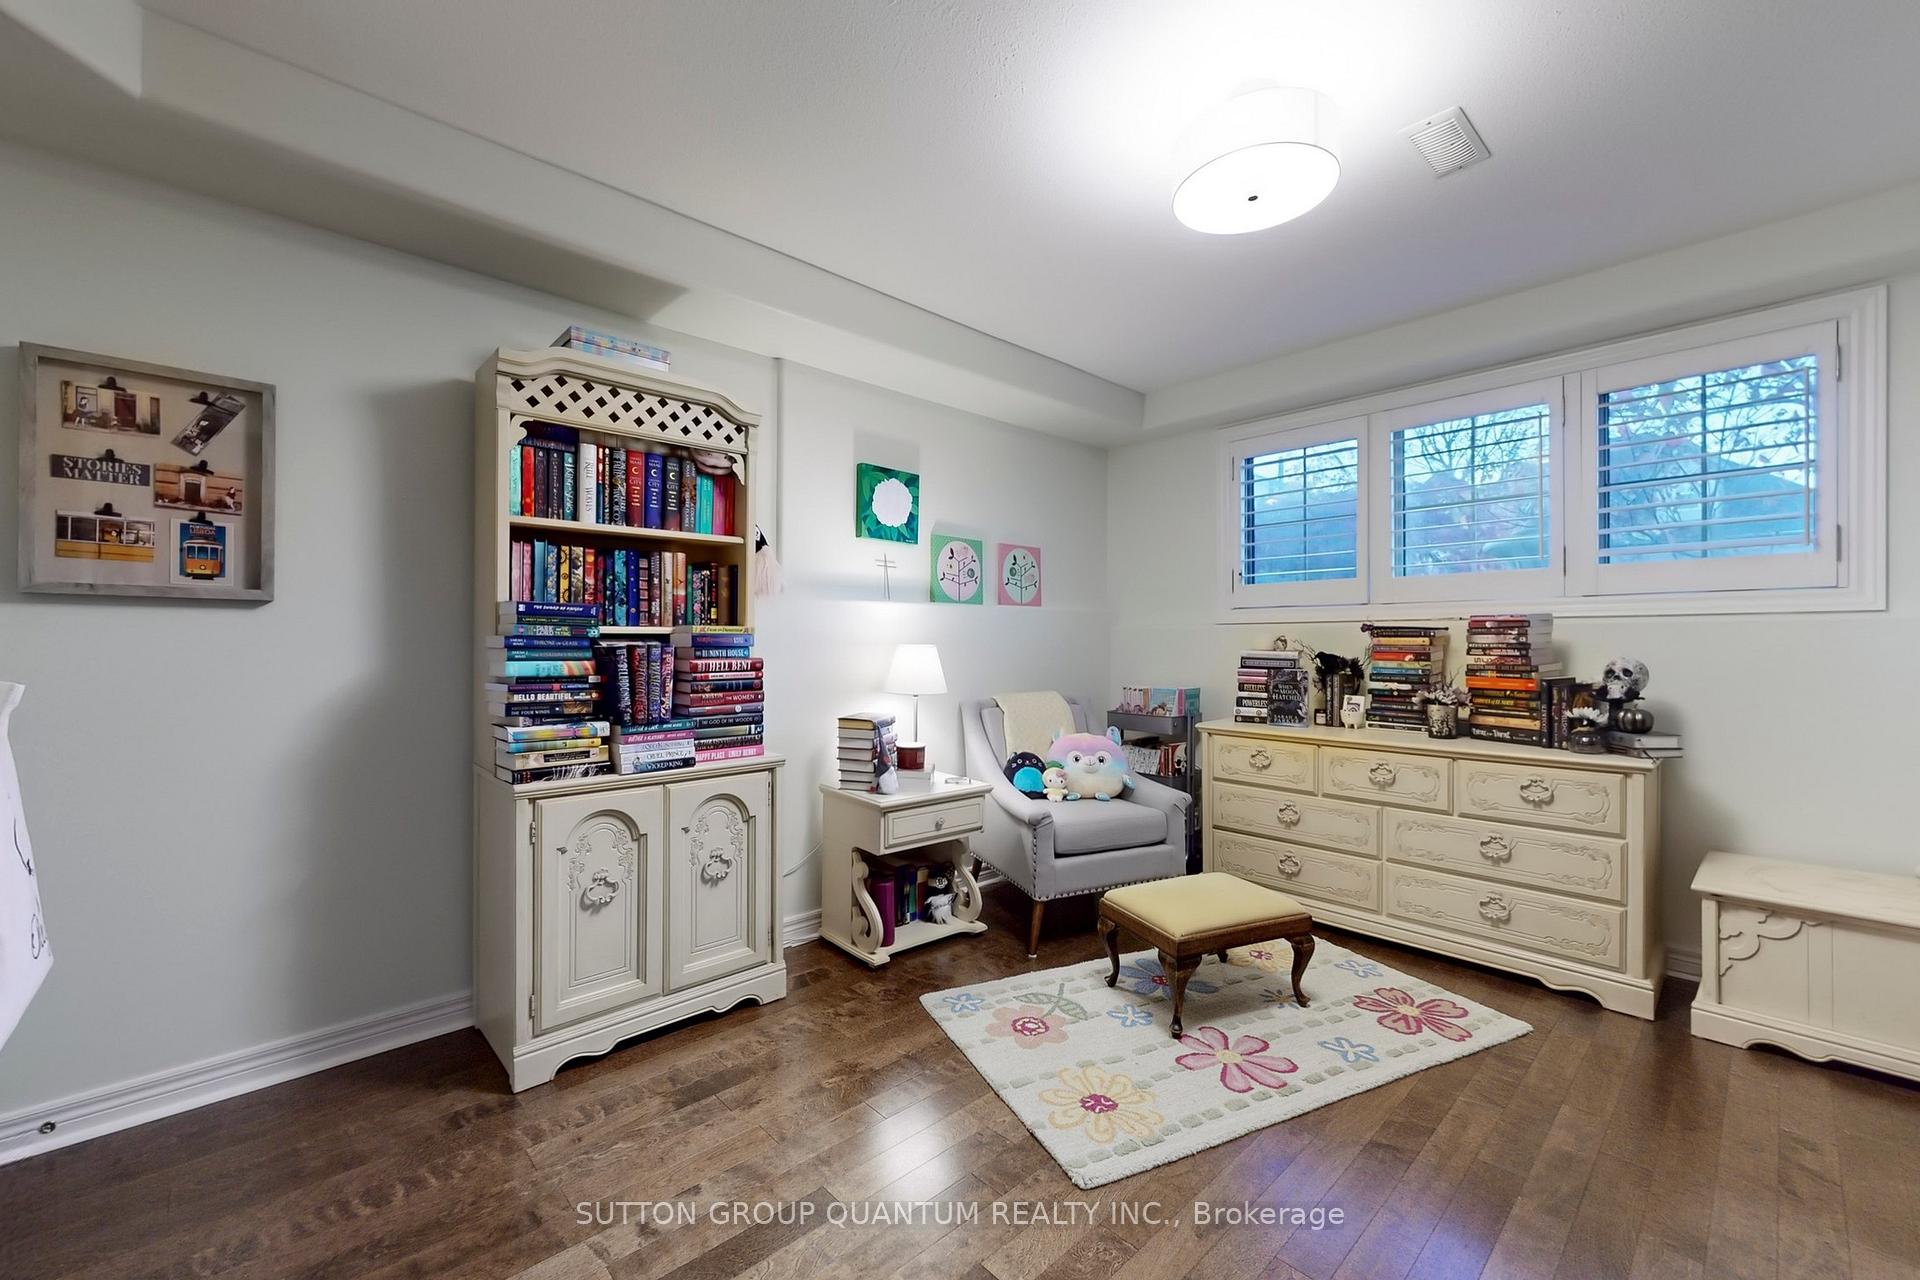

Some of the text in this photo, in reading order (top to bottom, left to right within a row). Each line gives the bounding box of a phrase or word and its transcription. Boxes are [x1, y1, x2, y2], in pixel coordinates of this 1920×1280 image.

[63, 456, 142, 476] STORIES
[63, 467, 141, 485] MATTER
[709, 660, 752, 672] HELL BENT
[513, 693, 535, 701] HELLO
[537, 692, 573, 701] BEAUTIFUL
[668, 759, 683, 768] KING
